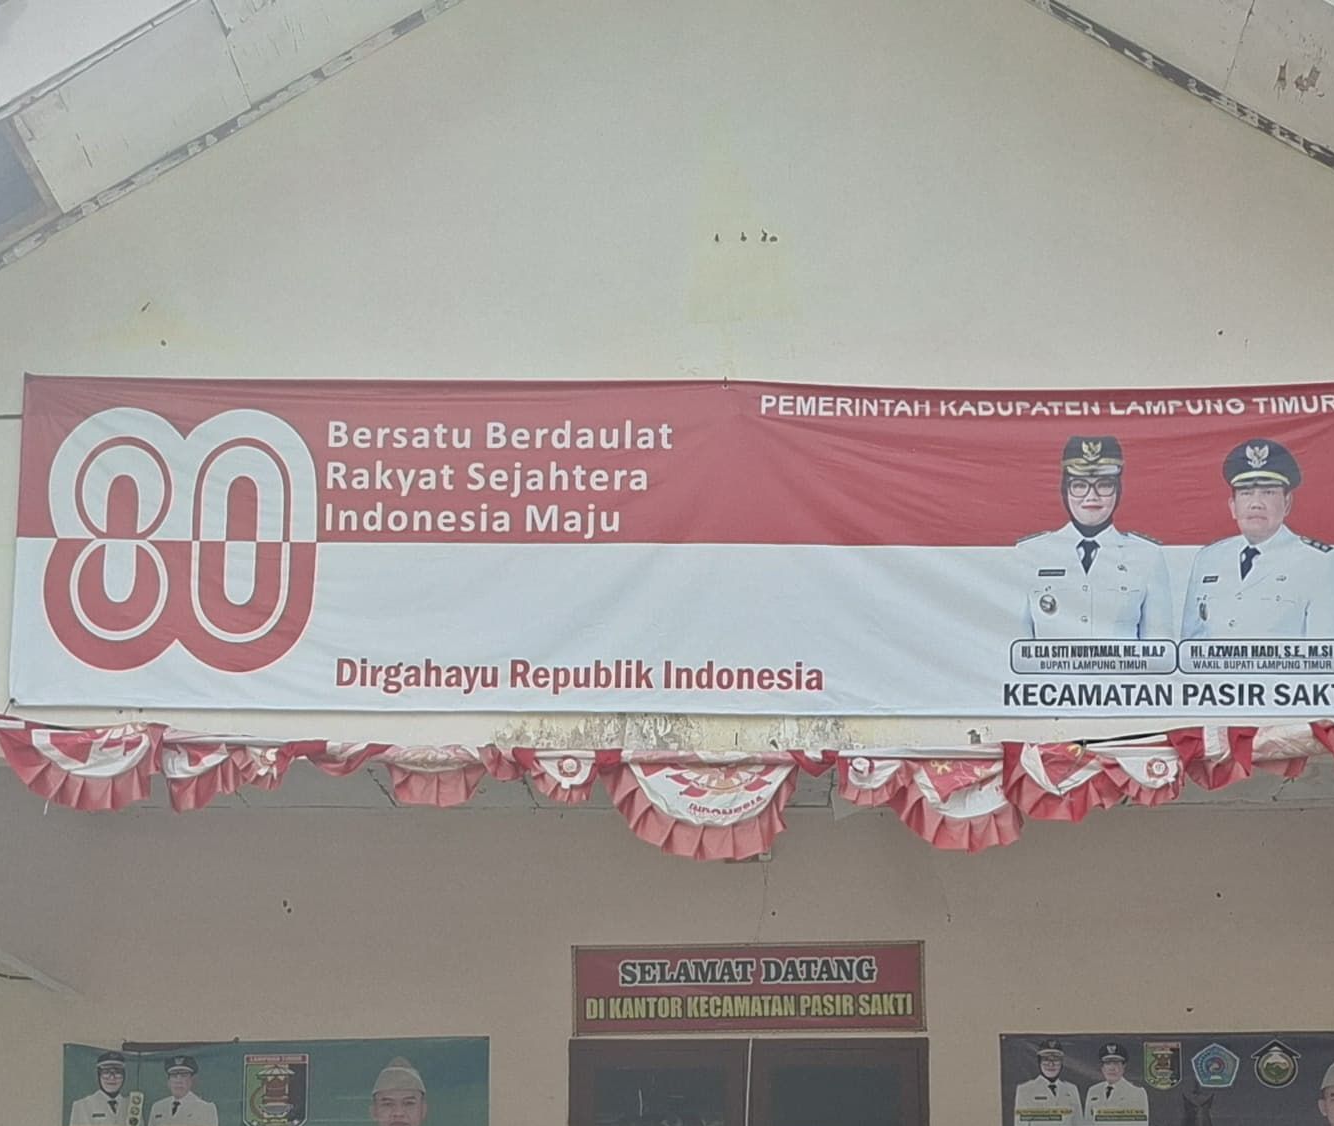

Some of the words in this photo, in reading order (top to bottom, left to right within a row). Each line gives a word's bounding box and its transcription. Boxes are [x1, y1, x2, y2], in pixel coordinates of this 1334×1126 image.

[760, 394, 930, 417] PEMERINTAH
[327, 420, 473, 450] Bersatu
[486, 420, 673, 451] Berdaulat
[325, 463, 455, 495] Rakyat
[467, 463, 649, 496] Sejahtera
[325, 503, 511, 534] Indonesia
[525, 505, 621, 539] Maju
[1034, 646, 1050, 658] ELA
[1052, 646, 1068, 658] SITI
[1210, 645, 1248, 658] AZWAR
[1251, 645, 1281, 659] HADI,
[335, 657, 500, 697] Dirgahayu
[509, 657, 654, 693] Republik
[664, 659, 824, 693] Indonesia
[1040, 661, 1070, 671] BUPATI
[1072, 661, 1116, 671] LAMPUNG
[1119, 660, 1147, 671] TIMUR
[1193, 661, 1221, 671] WAKIL
[1223, 661, 1254, 671] BUPATI
[1256, 661, 1301, 671] LAMPUNG
[1303, 660, 1332, 671] TIMUR
[1003, 683, 1173, 707] KECAMATAN
[1182, 683, 1265, 707] PASIR
[620, 959, 754, 985] SELAMAT
[761, 957, 876, 983] DATANG
[586, 998, 605, 1019] DI
[609, 996, 682, 1019] KANTOR
[687, 995, 795, 1018] KECAMATAN
[800, 994, 854, 1017] PASIR
[858, 994, 913, 1016] SAKTI
